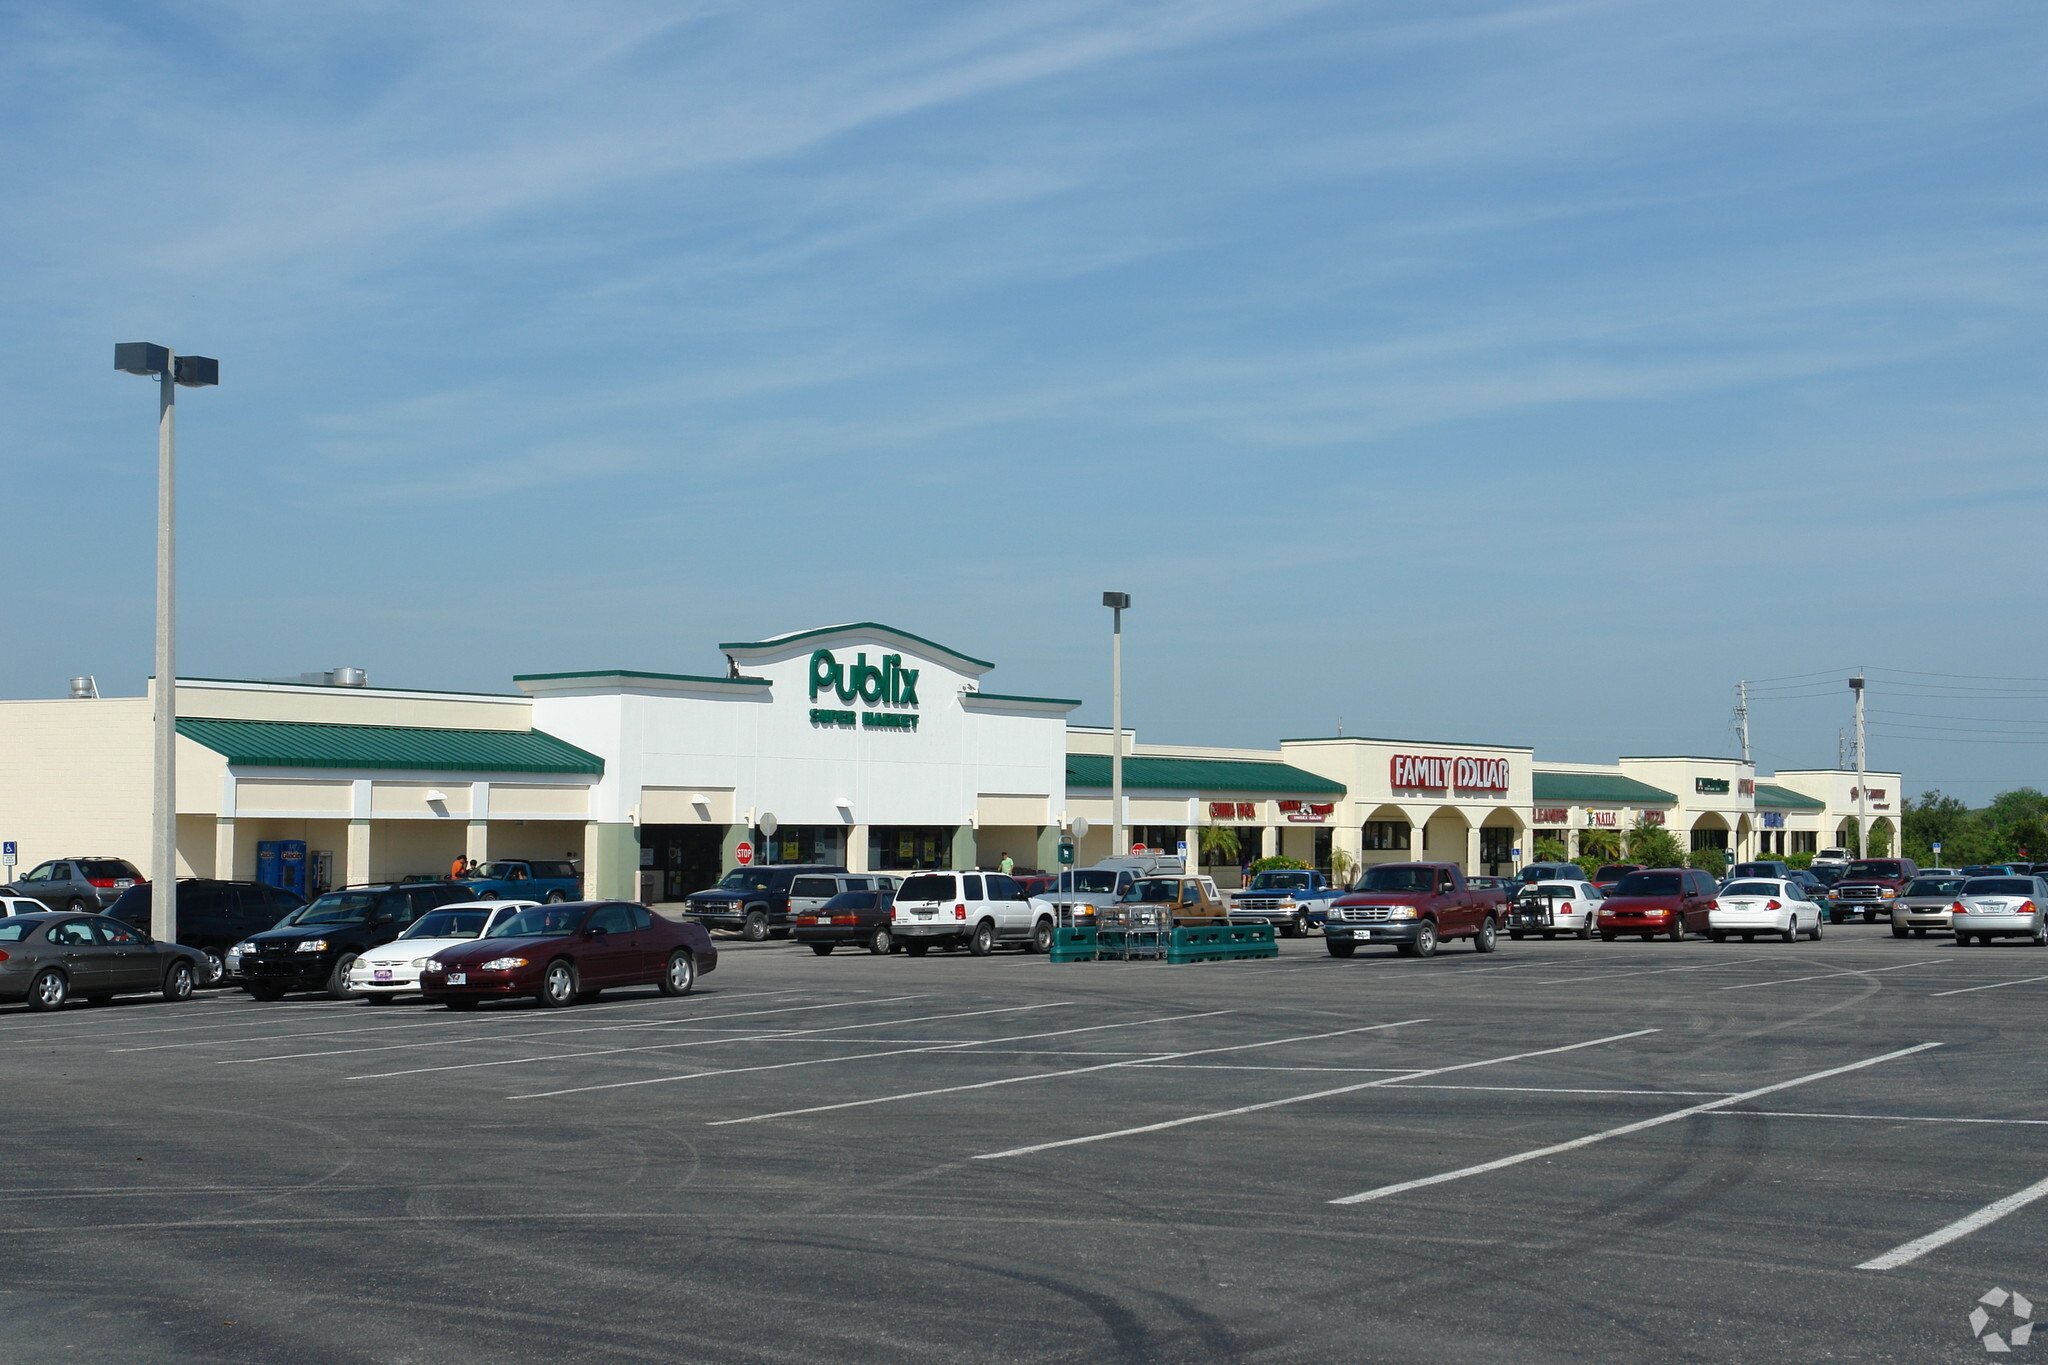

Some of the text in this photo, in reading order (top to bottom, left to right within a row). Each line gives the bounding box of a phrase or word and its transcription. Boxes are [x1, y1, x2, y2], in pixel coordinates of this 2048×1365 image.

[809, 649, 919, 704] Publix
[809, 709, 919, 728] SUPER MARKET
[1390, 755, 1509, 791] FAMILY DOLLAR
[1209, 802, 1256, 818] CHINA WOK
[736, 848, 751, 858] STOP
